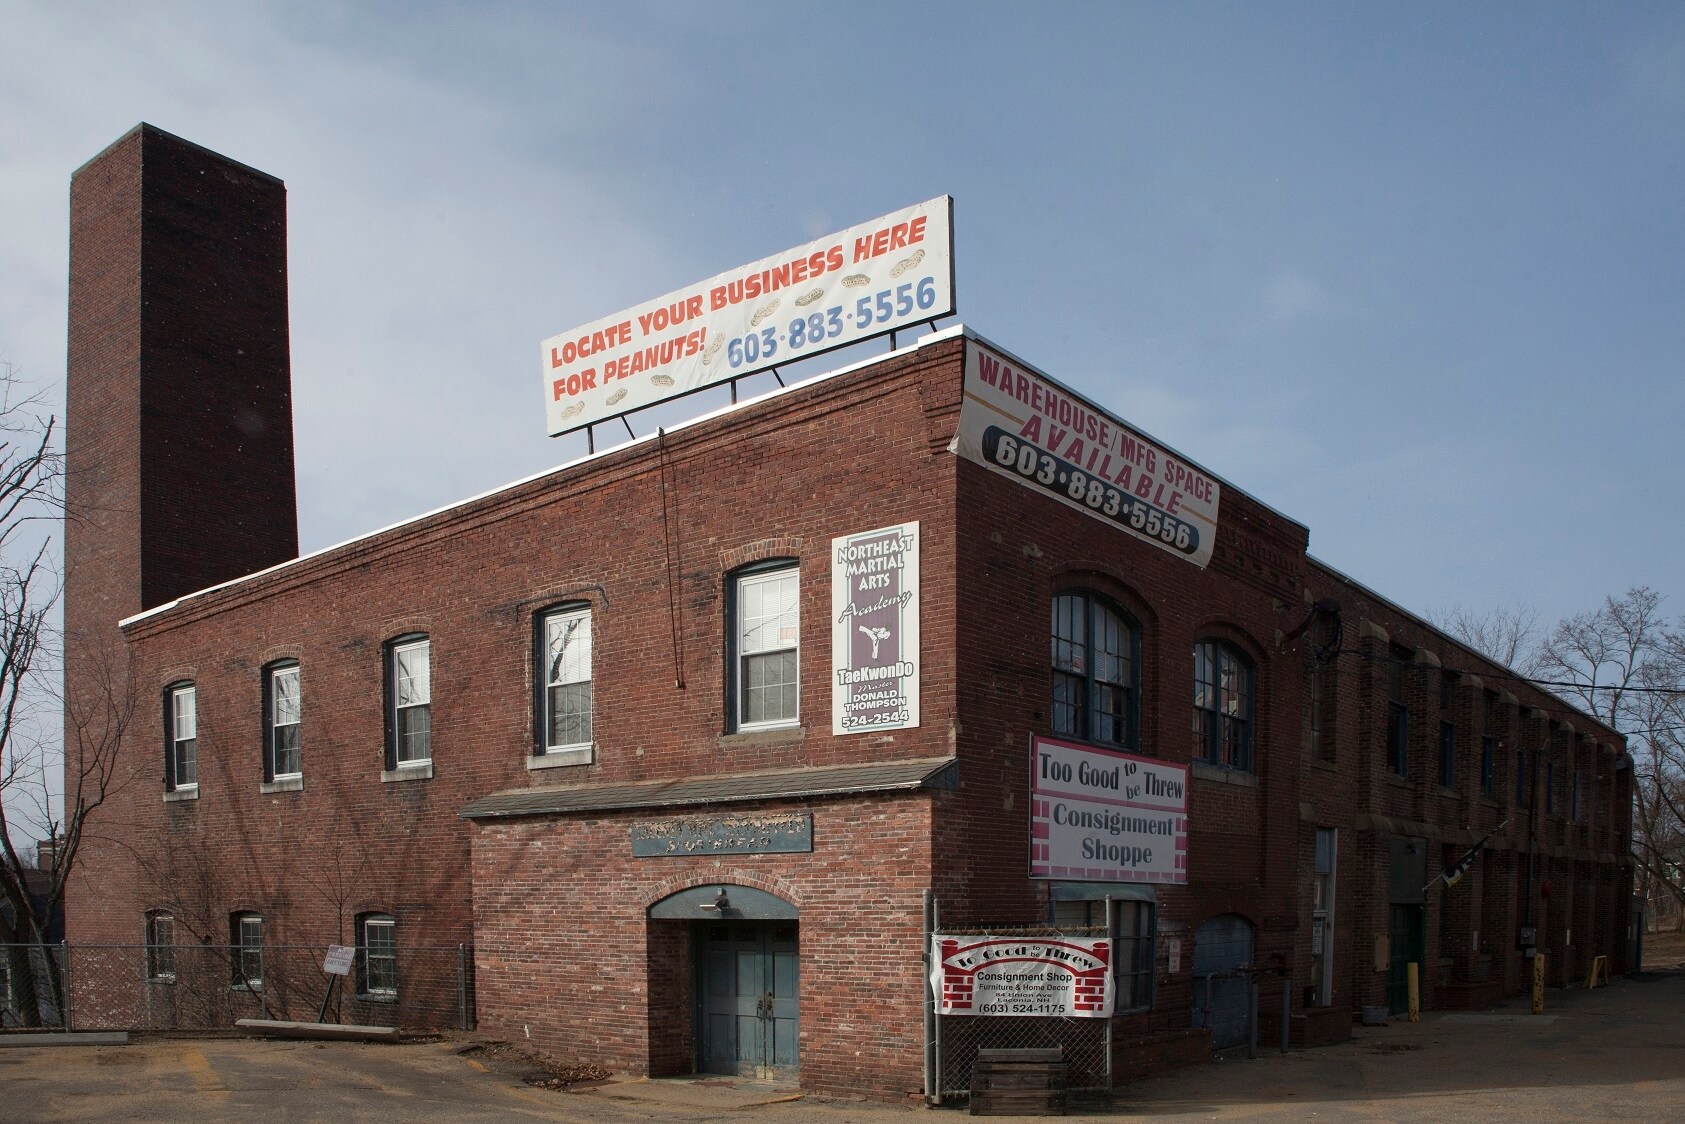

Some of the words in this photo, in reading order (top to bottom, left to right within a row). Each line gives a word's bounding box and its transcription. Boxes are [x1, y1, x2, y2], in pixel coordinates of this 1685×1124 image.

[551, 321, 632, 369] LOCATE
[638, 294, 704, 333] YOUR
[710, 244, 844, 312] BUSINESS
[853, 215, 928, 264] HERE
[553, 367, 597, 402] FOR
[603, 326, 706, 386] PEANUTS!
[1019, 414, 1184, 516] AVAILABLE
[1164, 459, 1213, 505] SPACE
[837, 534, 914, 565] NORTHEAST
[845, 553, 904, 578] MARTIAL
[858, 572, 890, 592] ARTS
[838, 587, 913, 623] Academy
[844, 696, 907, 713] THOMPSON
[853, 689, 898, 703] DONALD
[841, 709, 909, 728] 524-2544
[1039, 752, 1072, 783] Too
[1078, 760, 1119, 790] Good
[1124, 762, 1137, 776] to
[1126, 784, 1141, 800] be
[1143, 771, 1184, 799] Threw
[1053, 803, 1173, 836] Consignment
[1082, 837, 1152, 867] Shoppe
[956, 957, 977, 968] To
[982, 946, 1027, 960] Good
[1044, 947, 1097, 969] Threw
[977, 971, 1044, 983] Consignment
[1046, 971, 1073, 983] Shop
[979, 983, 1013, 991] Furniture
[1023, 983, 1045, 991] Home
[979, 1003, 1008, 1013] (603)
[1012, 1004, 1065, 1013] 524-1175
